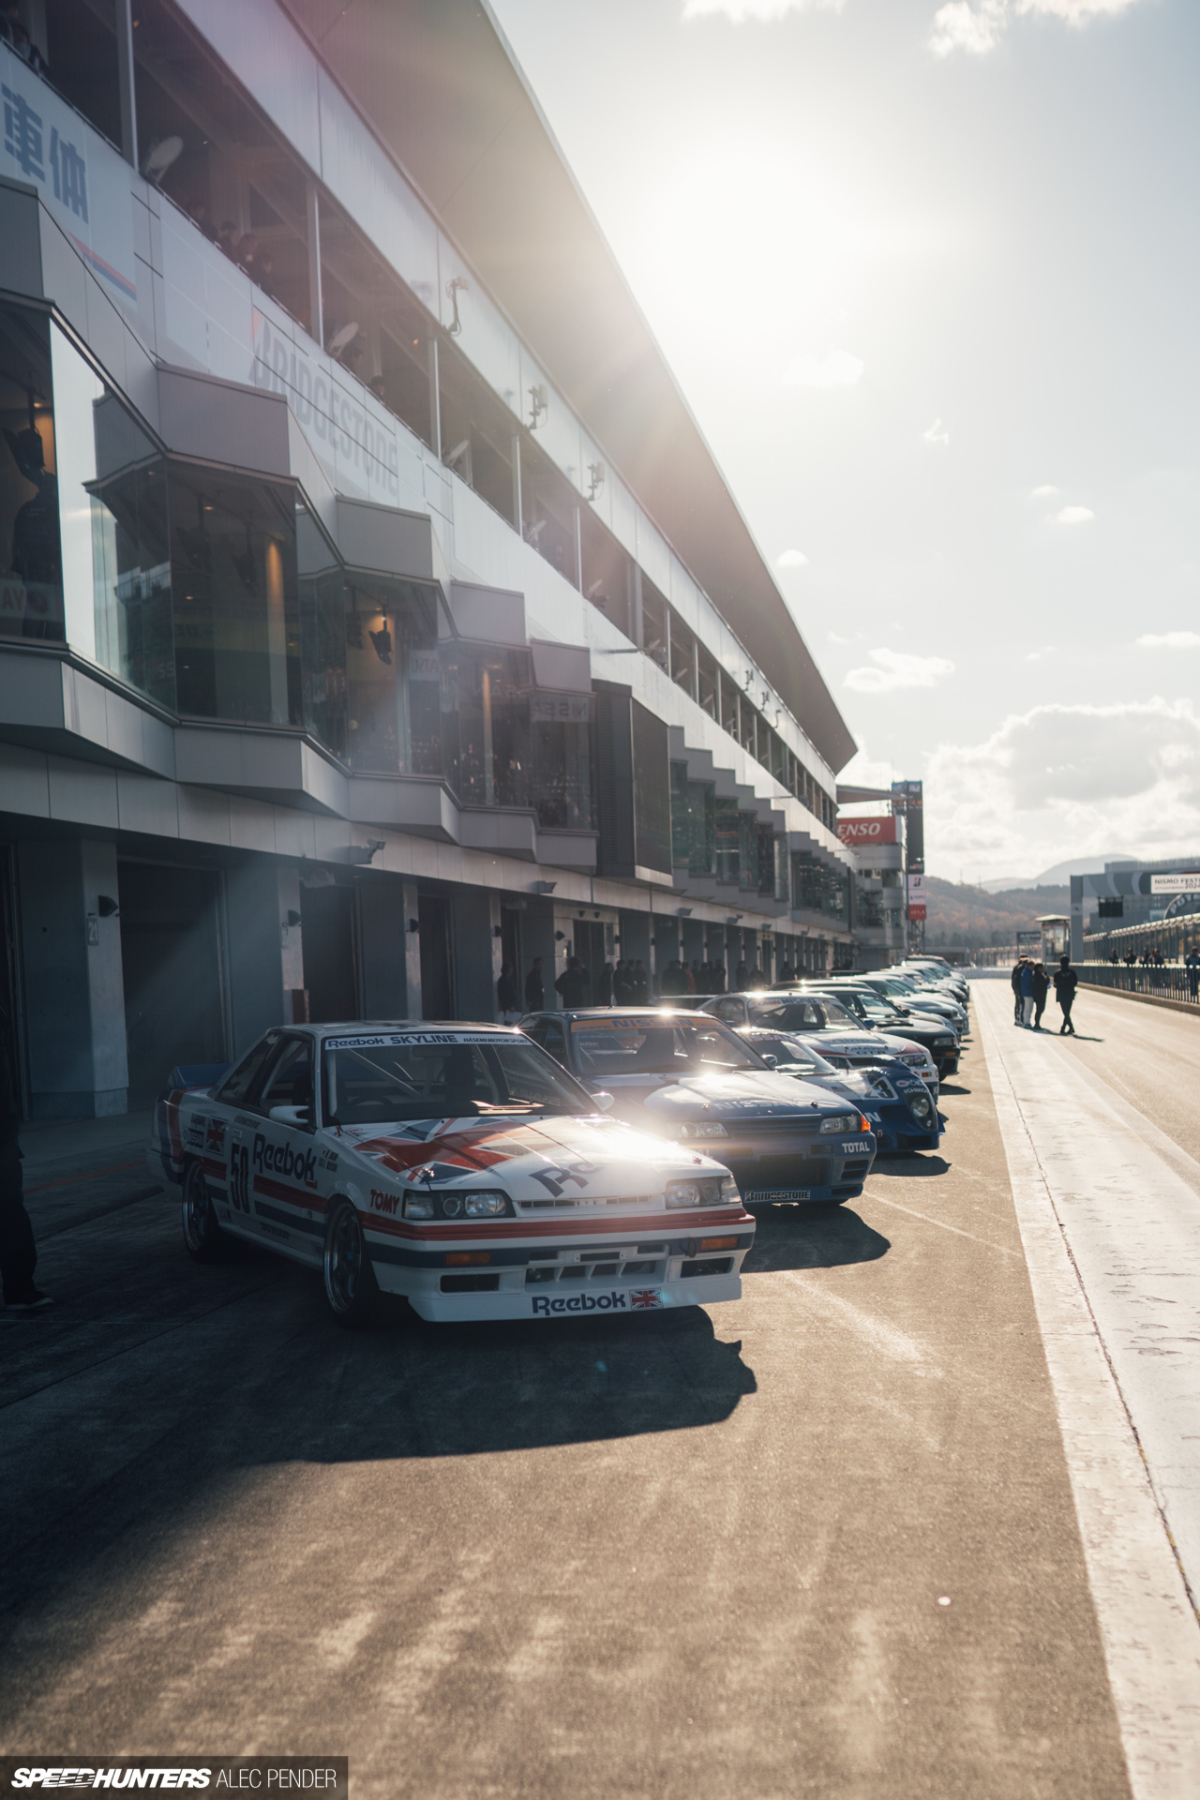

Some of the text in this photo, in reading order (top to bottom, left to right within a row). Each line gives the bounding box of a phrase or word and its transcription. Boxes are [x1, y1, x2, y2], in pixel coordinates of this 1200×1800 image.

[248, 317, 398, 498] BRIDGESTONE
[837, 822, 881, 837] ENSO
[88, 922, 98, 941] 21
[611, 1018, 695, 1029] NISSAN
[328, 1037, 384, 1048] Reebok
[390, 1034, 458, 1045] SKYLINE
[841, 1141, 870, 1153] TOTAL
[252, 1133, 317, 1181] Reebok
[230, 1142, 251, 1214] 50
[370, 1188, 400, 1215] TOMY
[745, 1190, 810, 1202] BRIDGESTONE
[532, 1291, 626, 1316] Reebok
